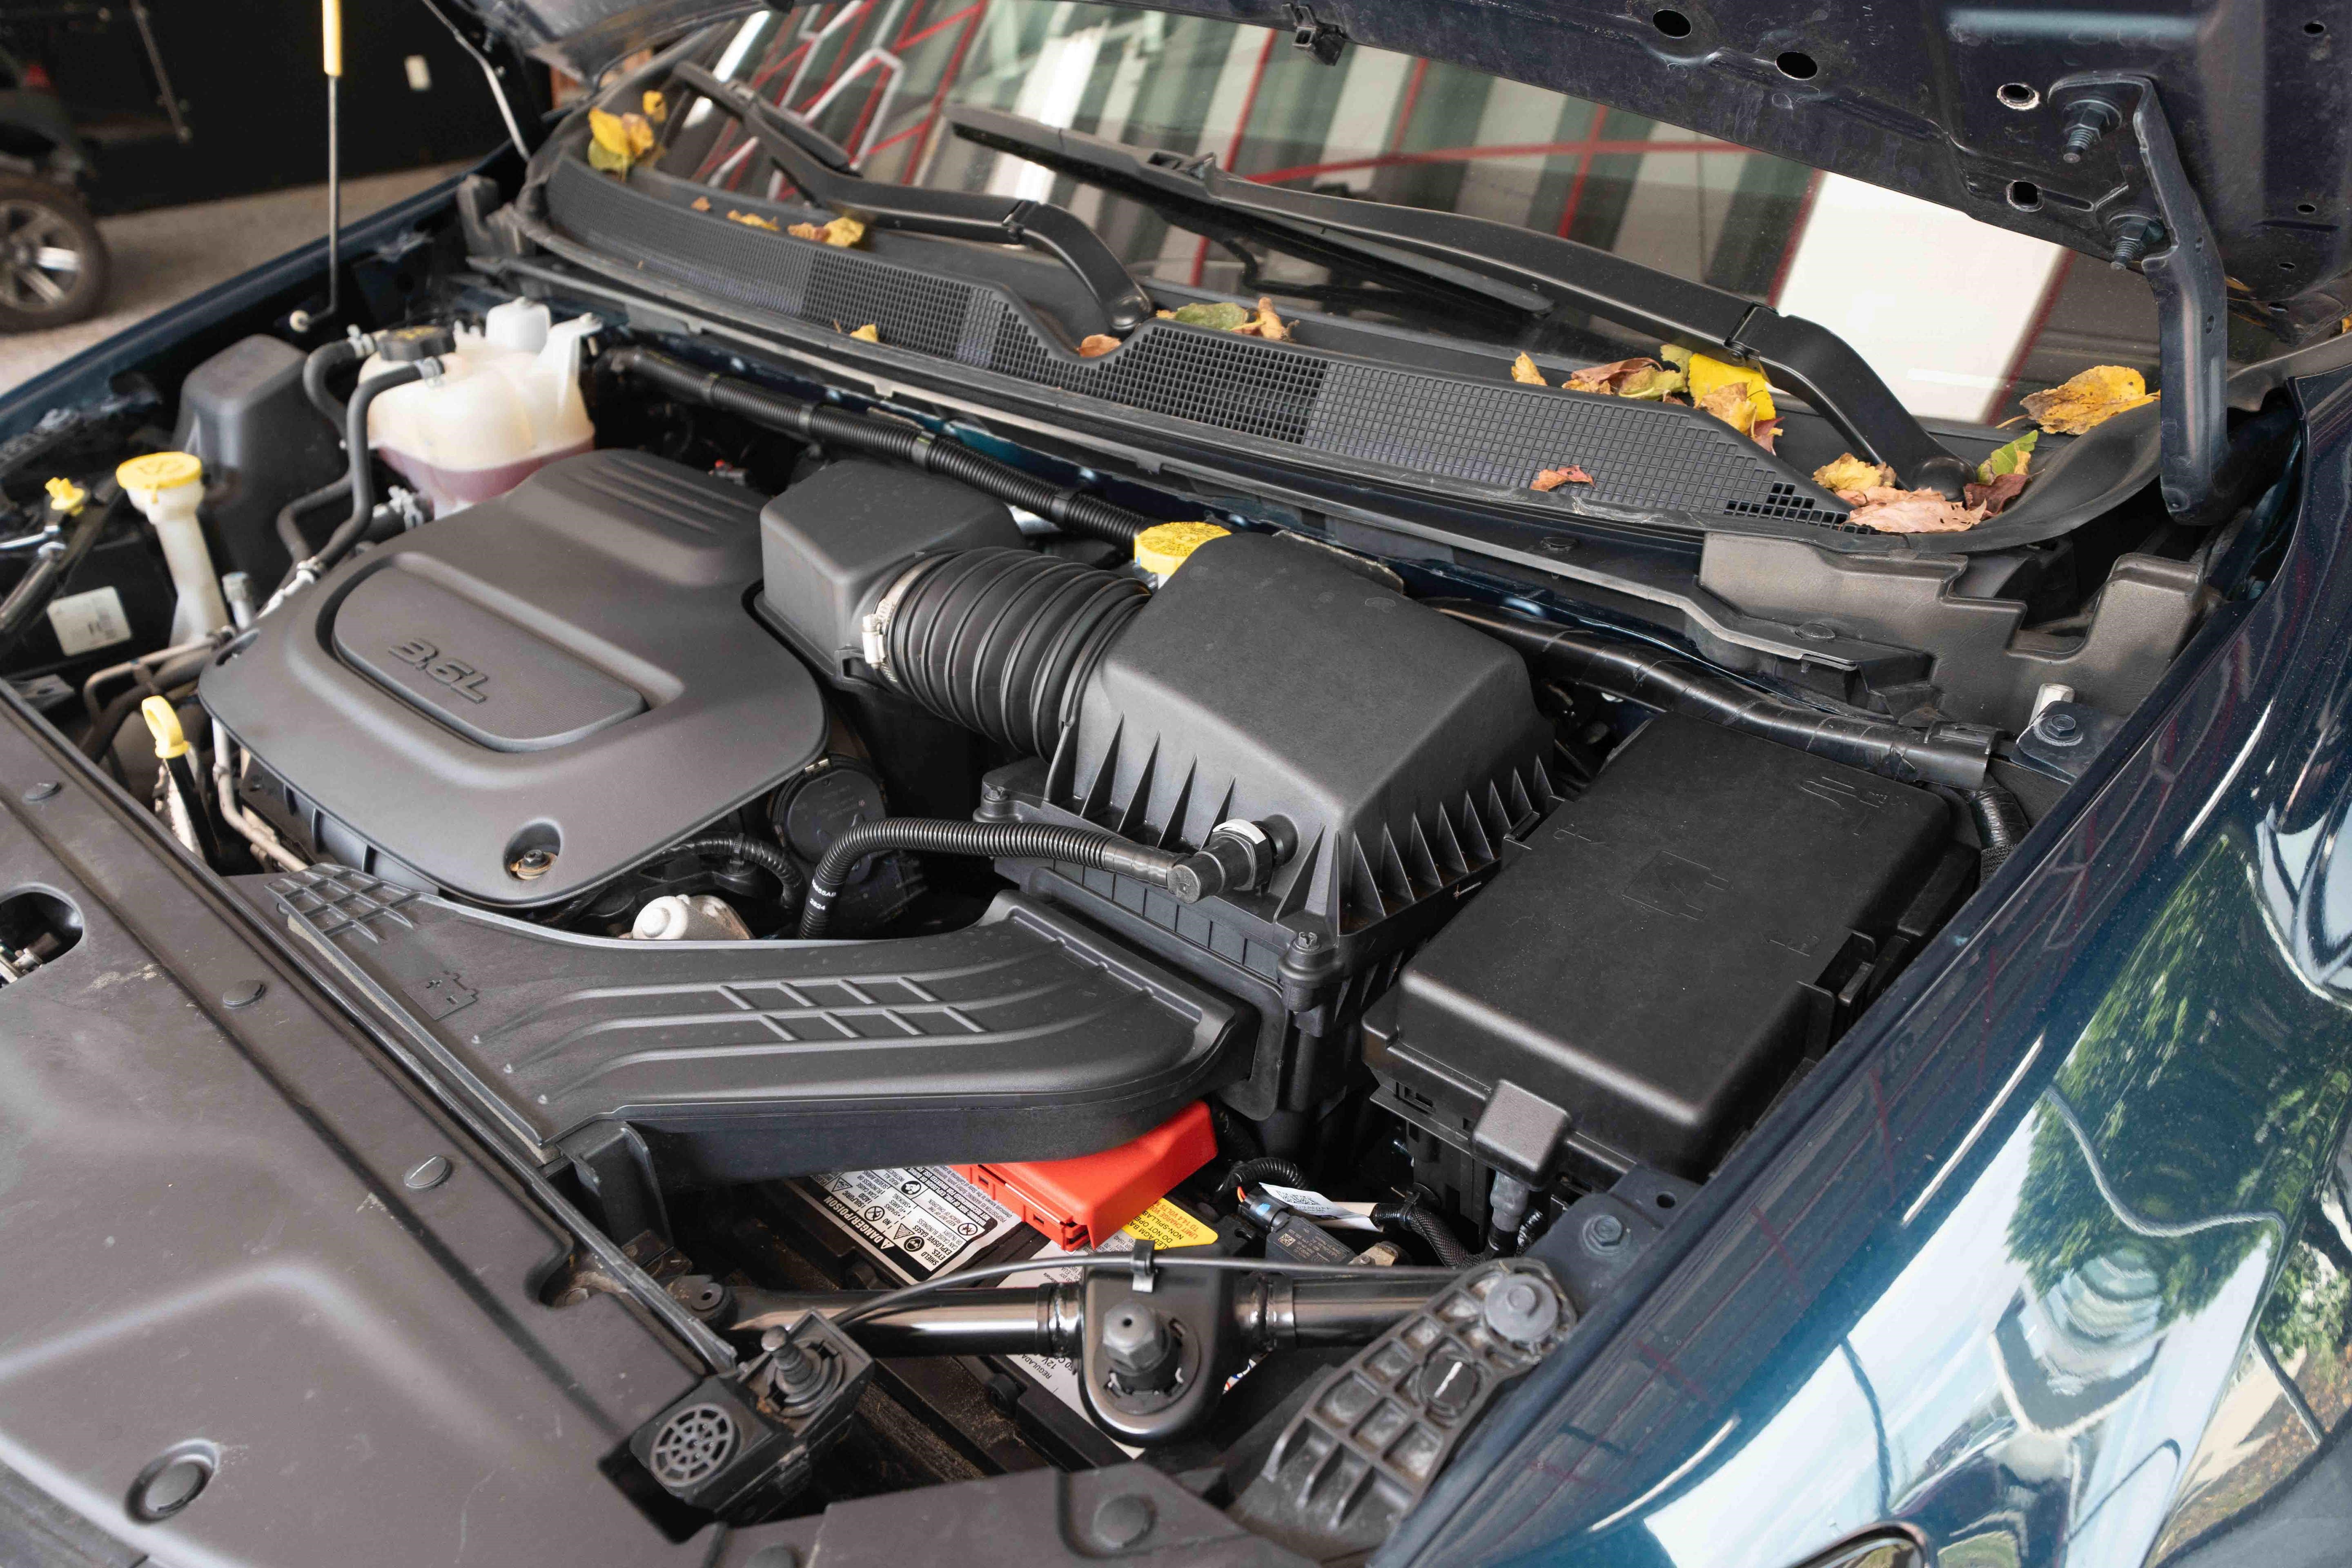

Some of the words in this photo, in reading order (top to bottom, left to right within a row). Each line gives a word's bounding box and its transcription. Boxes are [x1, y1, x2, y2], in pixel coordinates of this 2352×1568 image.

[388, 638, 488, 704] 3.6L
[856, 1183, 869, 1192] CAUSE
[862, 1178, 882, 1194] BLINDNESS
[873, 1178, 888, 1189] SEVERE
[889, 1177, 900, 1186] READ
[924, 1180, 946, 1196] EXPLOSION
[929, 1175, 949, 1190] INVERTED
[955, 1184, 968, 1194] Battery
[842, 1190, 864, 1207] SULFURIC
[858, 1193, 870, 1202] ACID
[953, 1193, 982, 1215] RECOMMENDED
[984, 1198, 996, 1207] known
[958, 1204, 969, 1213] RISK
[984, 1206, 1007, 1223] PROPOSITION
[995, 1205, 1012, 1218] chemicals
[1159, 1204, 1178, 1218] VOLTS
[822, 1195, 884, 1243] DANGER/POISON
[945, 1218, 956, 1227] KEEP
[949, 1214, 961, 1223] REACH
[966, 1211, 986, 1226] WARNING:
[980, 1212, 991, 1221] NOT
[1159, 1212, 1183, 1229] CHARGE
[1177, 1216, 1190, 1226] 14.4
[912, 1225, 929, 1237] GASES
[917, 1218, 939, 1235] BLINDNESS
[1141, 1209, 1184, 1240] NON-SPILLAB
[1148, 1225, 1163, 1236] NOT
[936, 1233, 950, 1243] CAUSE
[1138, 1227, 1154, 1240] AGM
[1161, 1234, 1173, 1243] DO
[1181, 1227, 1198, 1239] LIMIT
[926, 1235, 952, 1255] EXPLOSIVE
[920, 1251, 939, 1265] SHIELD
[931, 1249, 945, 1260] EYES.
[1021, 1354, 1052, 1379] REGULADA
[1041, 1356, 1057, 1370] 12V
